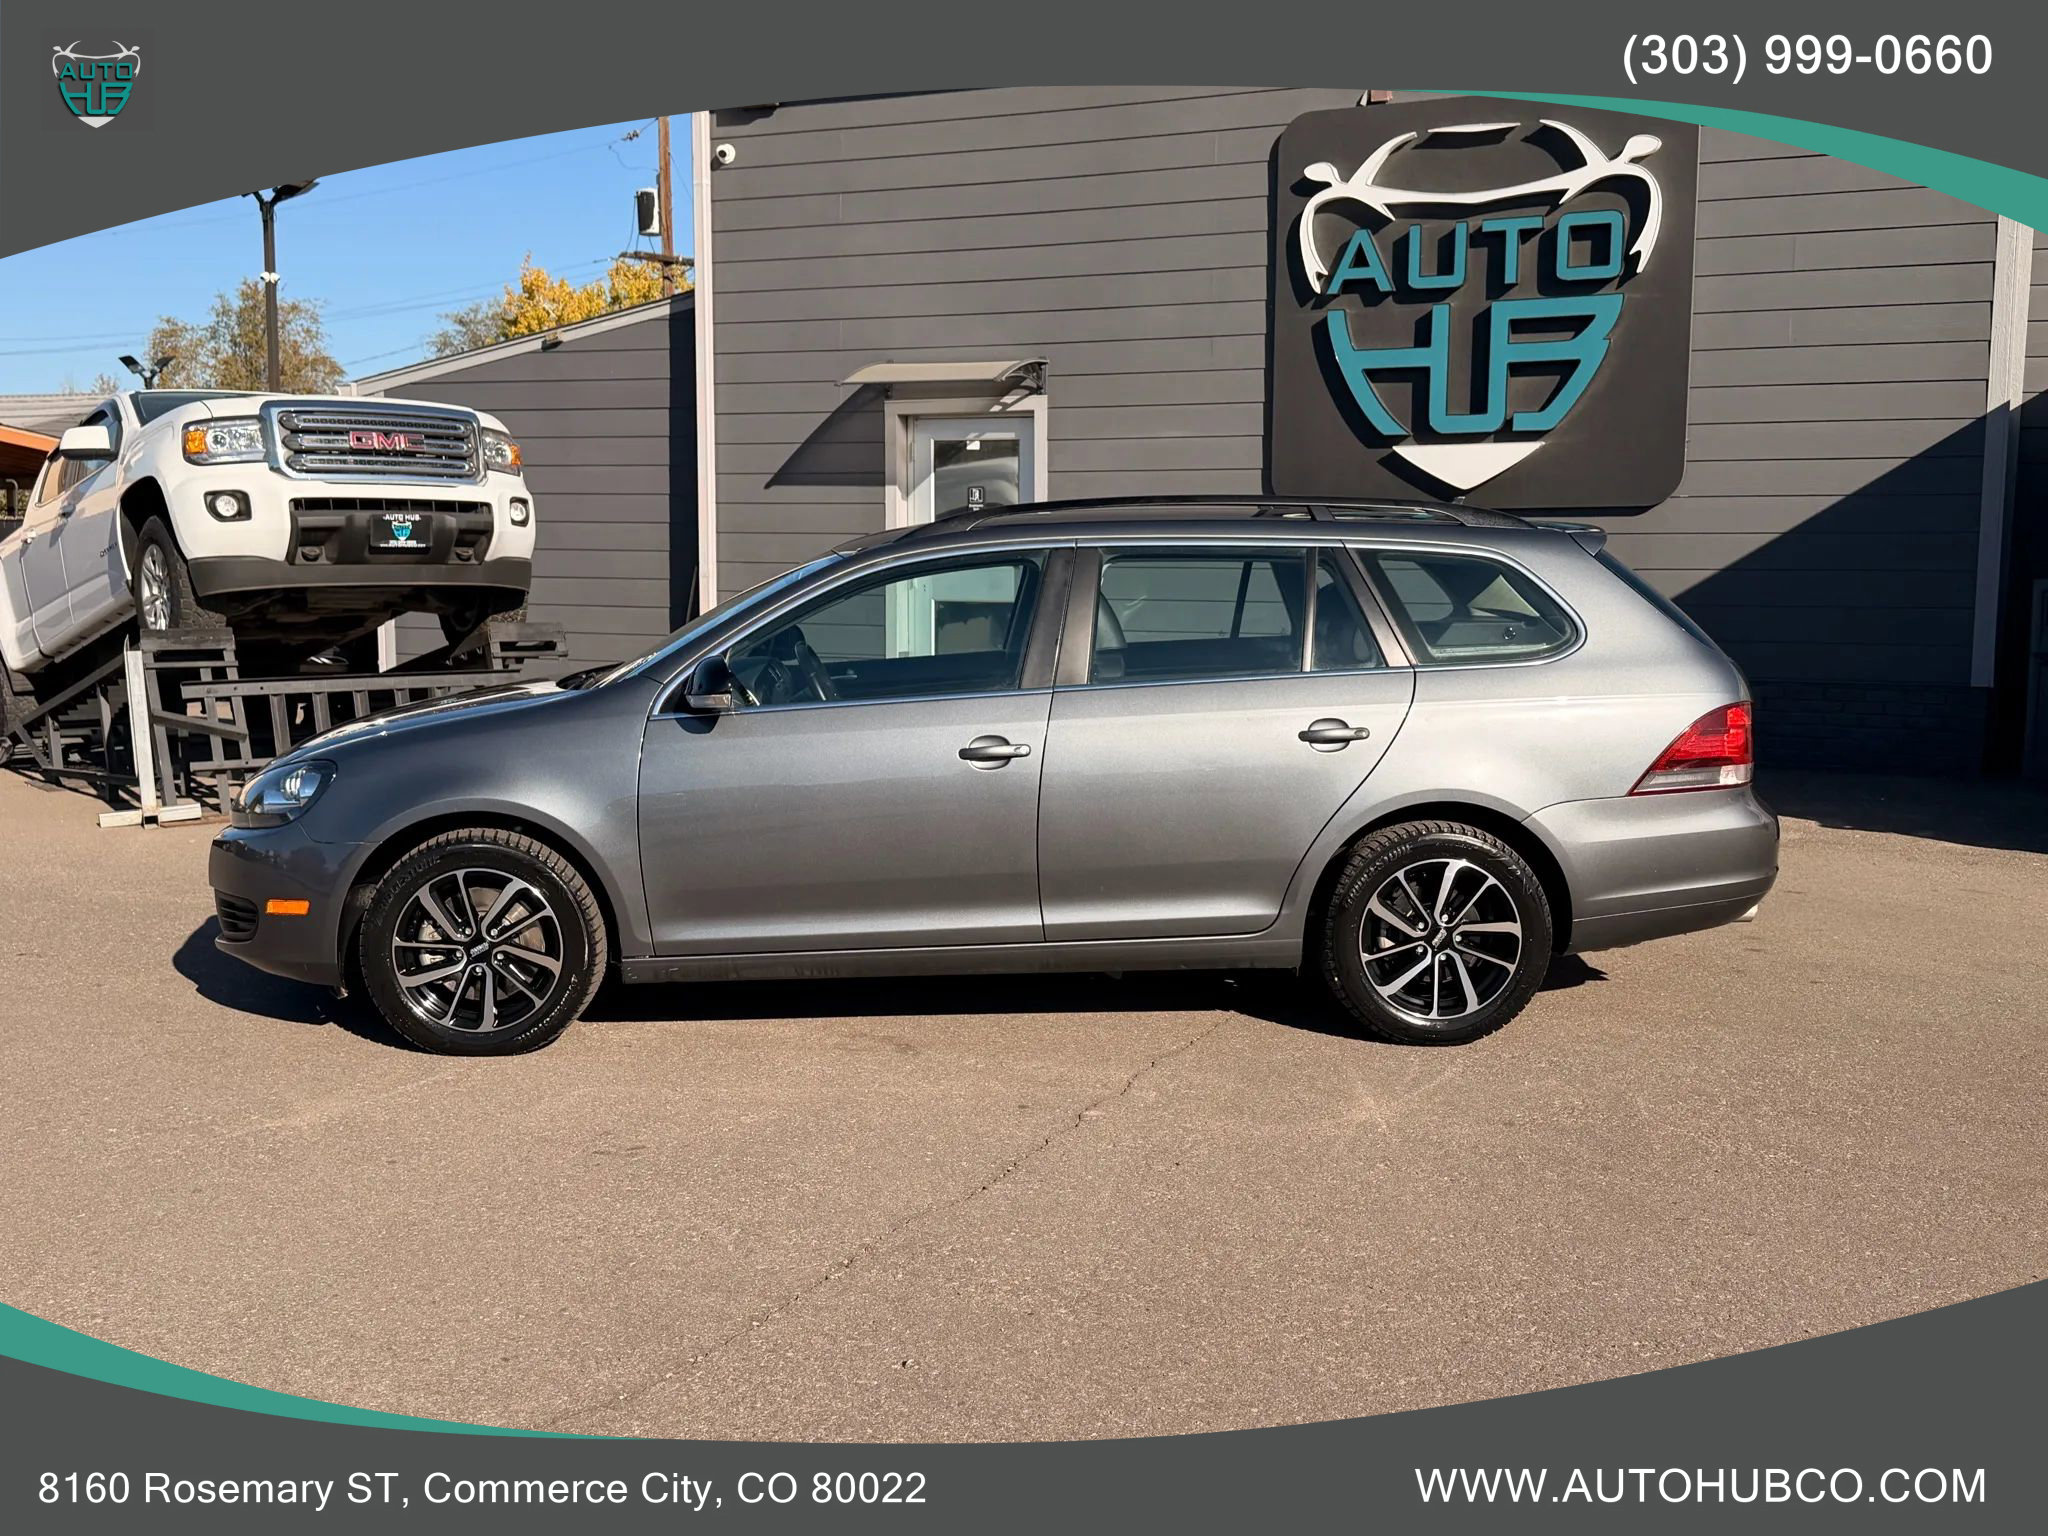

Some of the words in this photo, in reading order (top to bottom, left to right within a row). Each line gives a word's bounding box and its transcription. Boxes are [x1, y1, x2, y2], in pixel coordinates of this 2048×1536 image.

[1326, 209, 1625, 295] AUTO
[1327, 293, 1624, 436] HUB
[349, 431, 426, 452] GMC
[384, 513, 404, 521] AUTO
[404, 513, 420, 521] HUB
